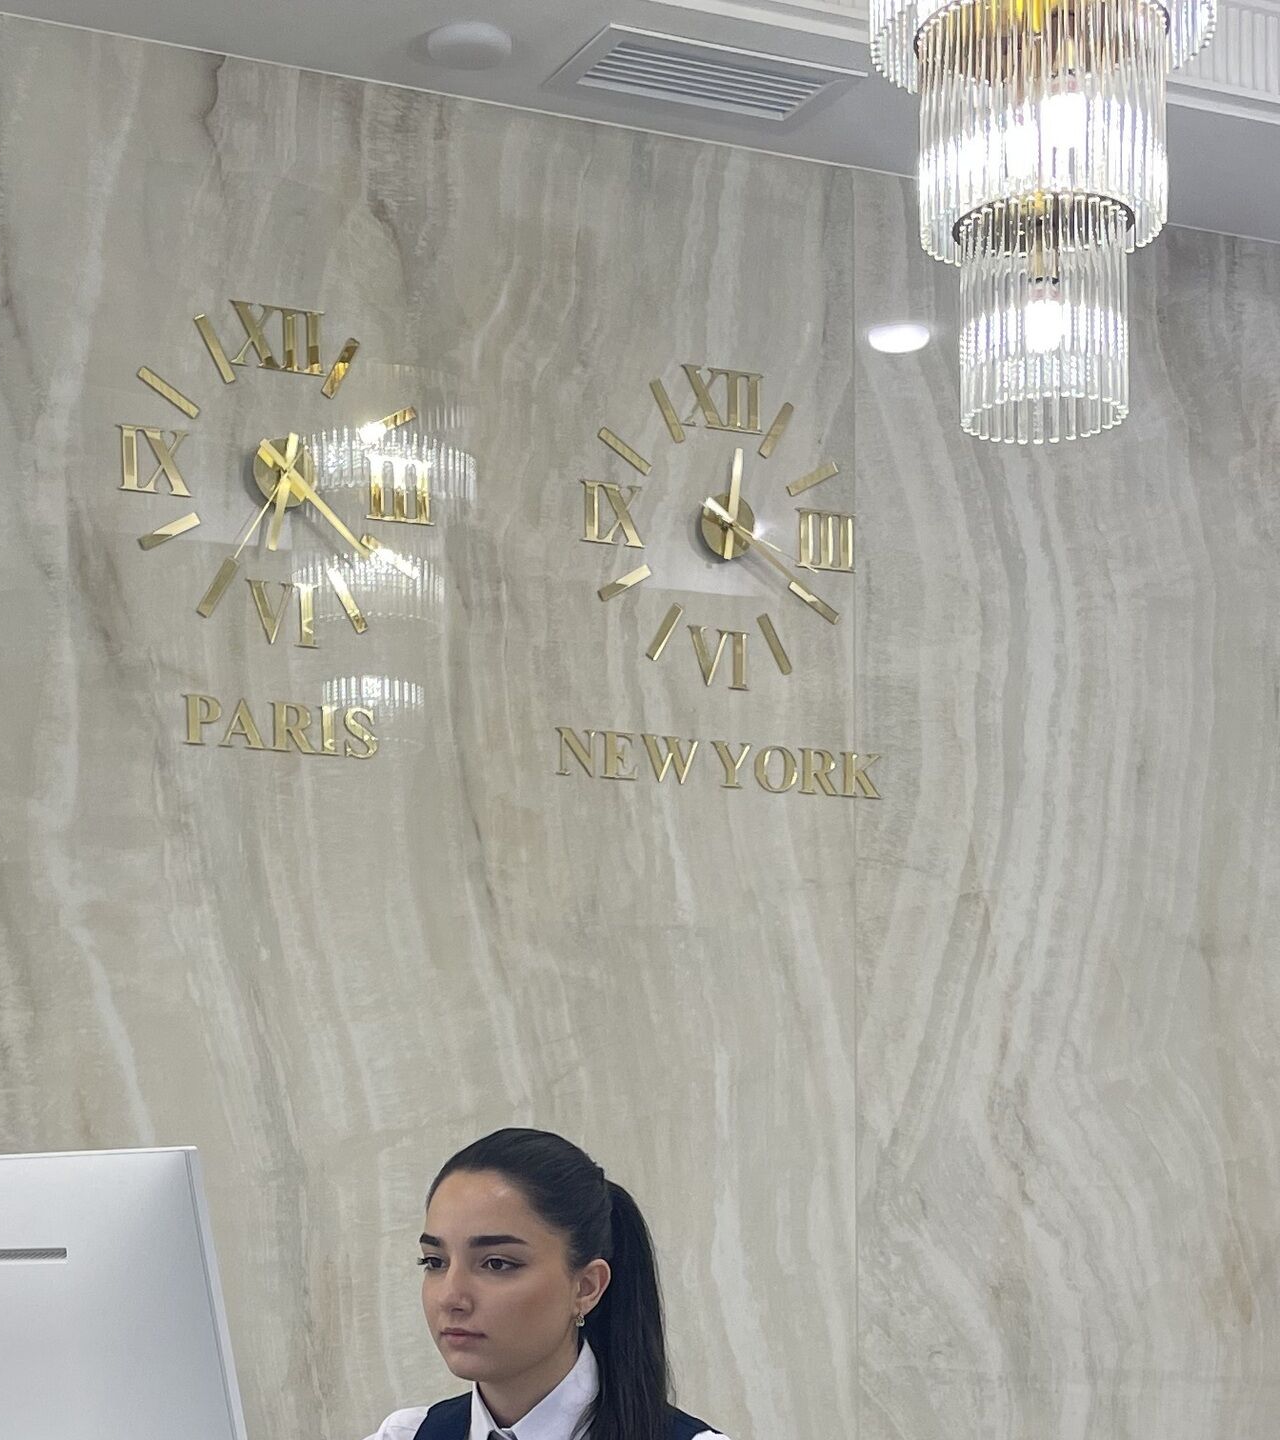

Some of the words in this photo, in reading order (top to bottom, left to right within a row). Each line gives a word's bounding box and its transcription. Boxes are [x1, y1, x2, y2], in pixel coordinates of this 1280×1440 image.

[229, 300, 325, 376] XII
[681, 363, 764, 434] XII
[118, 423, 192, 497] IX
[580, 479, 645, 549] IX
[795, 507, 856, 573] III
[246, 578, 320, 649] VI
[688, 624, 750, 691] VI
[182, 693, 379, 760] PARIS
[555, 727, 699, 785] NEW
[711, 739, 882, 801] YORK
